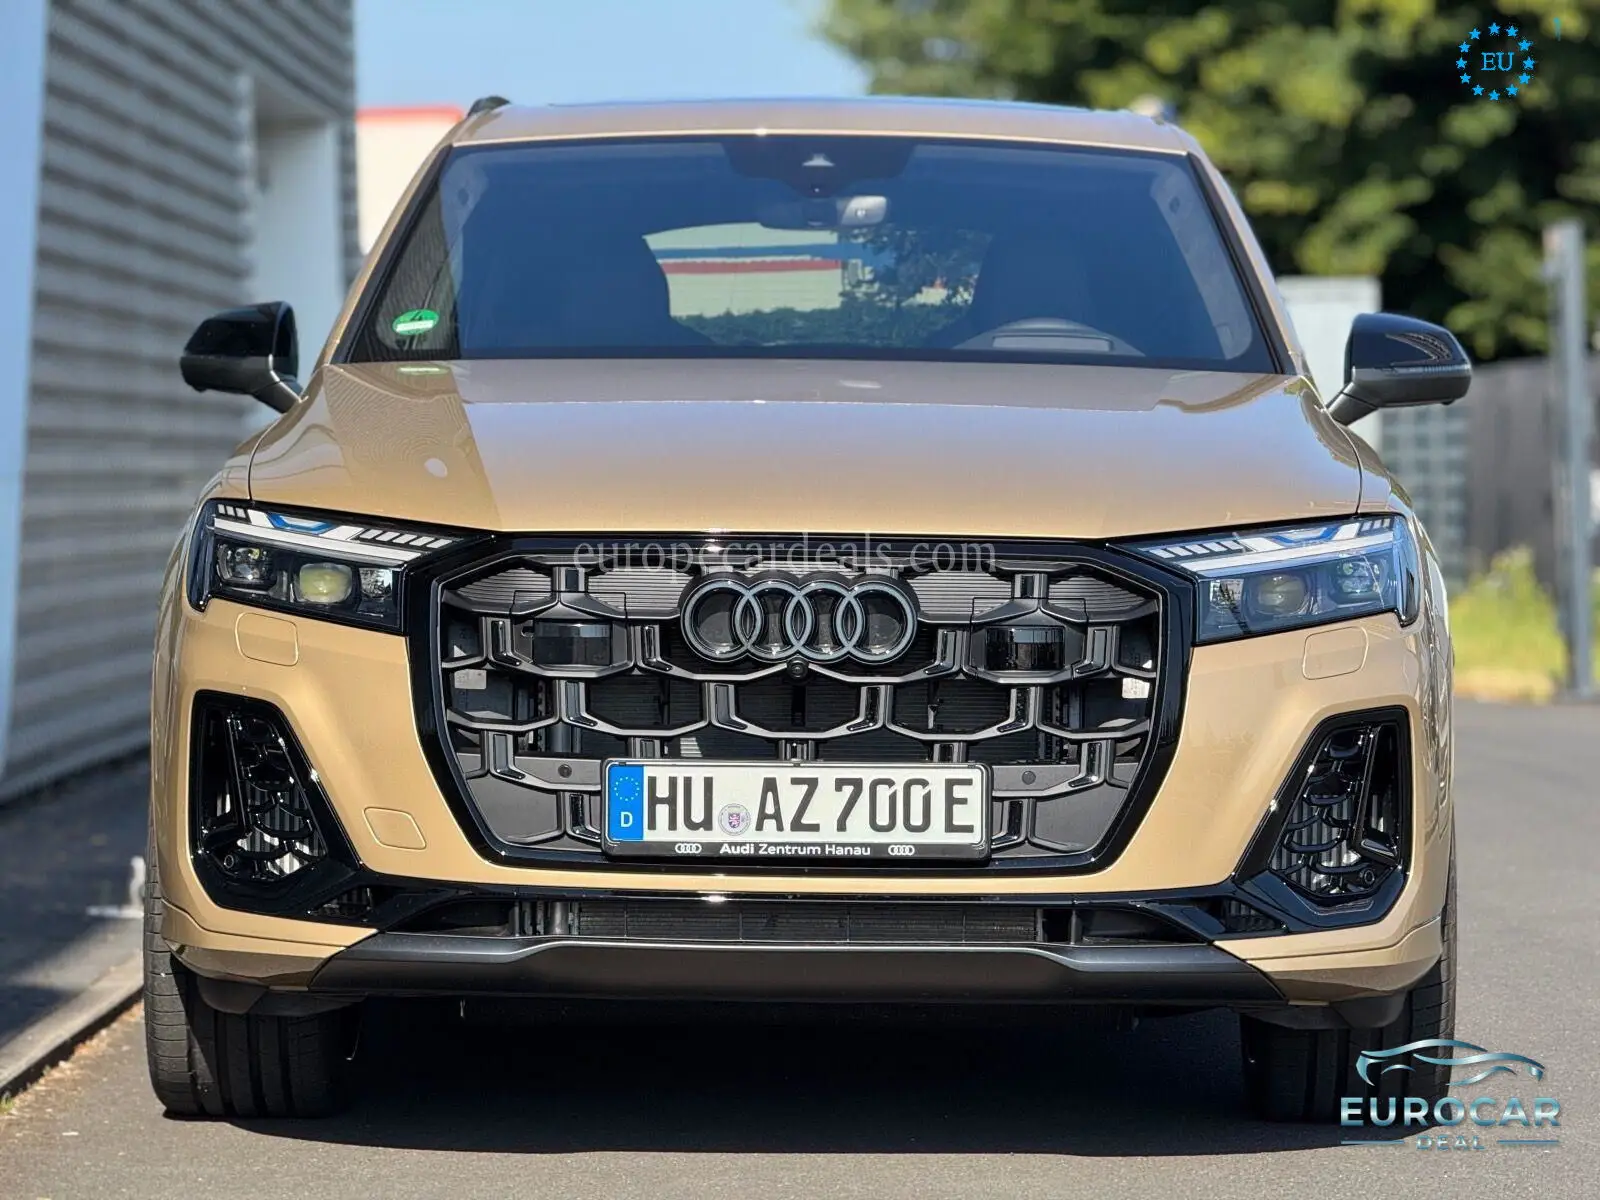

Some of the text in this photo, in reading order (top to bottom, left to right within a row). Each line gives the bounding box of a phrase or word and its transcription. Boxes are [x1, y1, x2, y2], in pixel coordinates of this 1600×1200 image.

[647, 776, 714, 832] HU
[755, 777, 820, 832] AZ
[620, 812, 633, 828] D
[719, 843, 871, 856] Audi Zentrum Hanau
